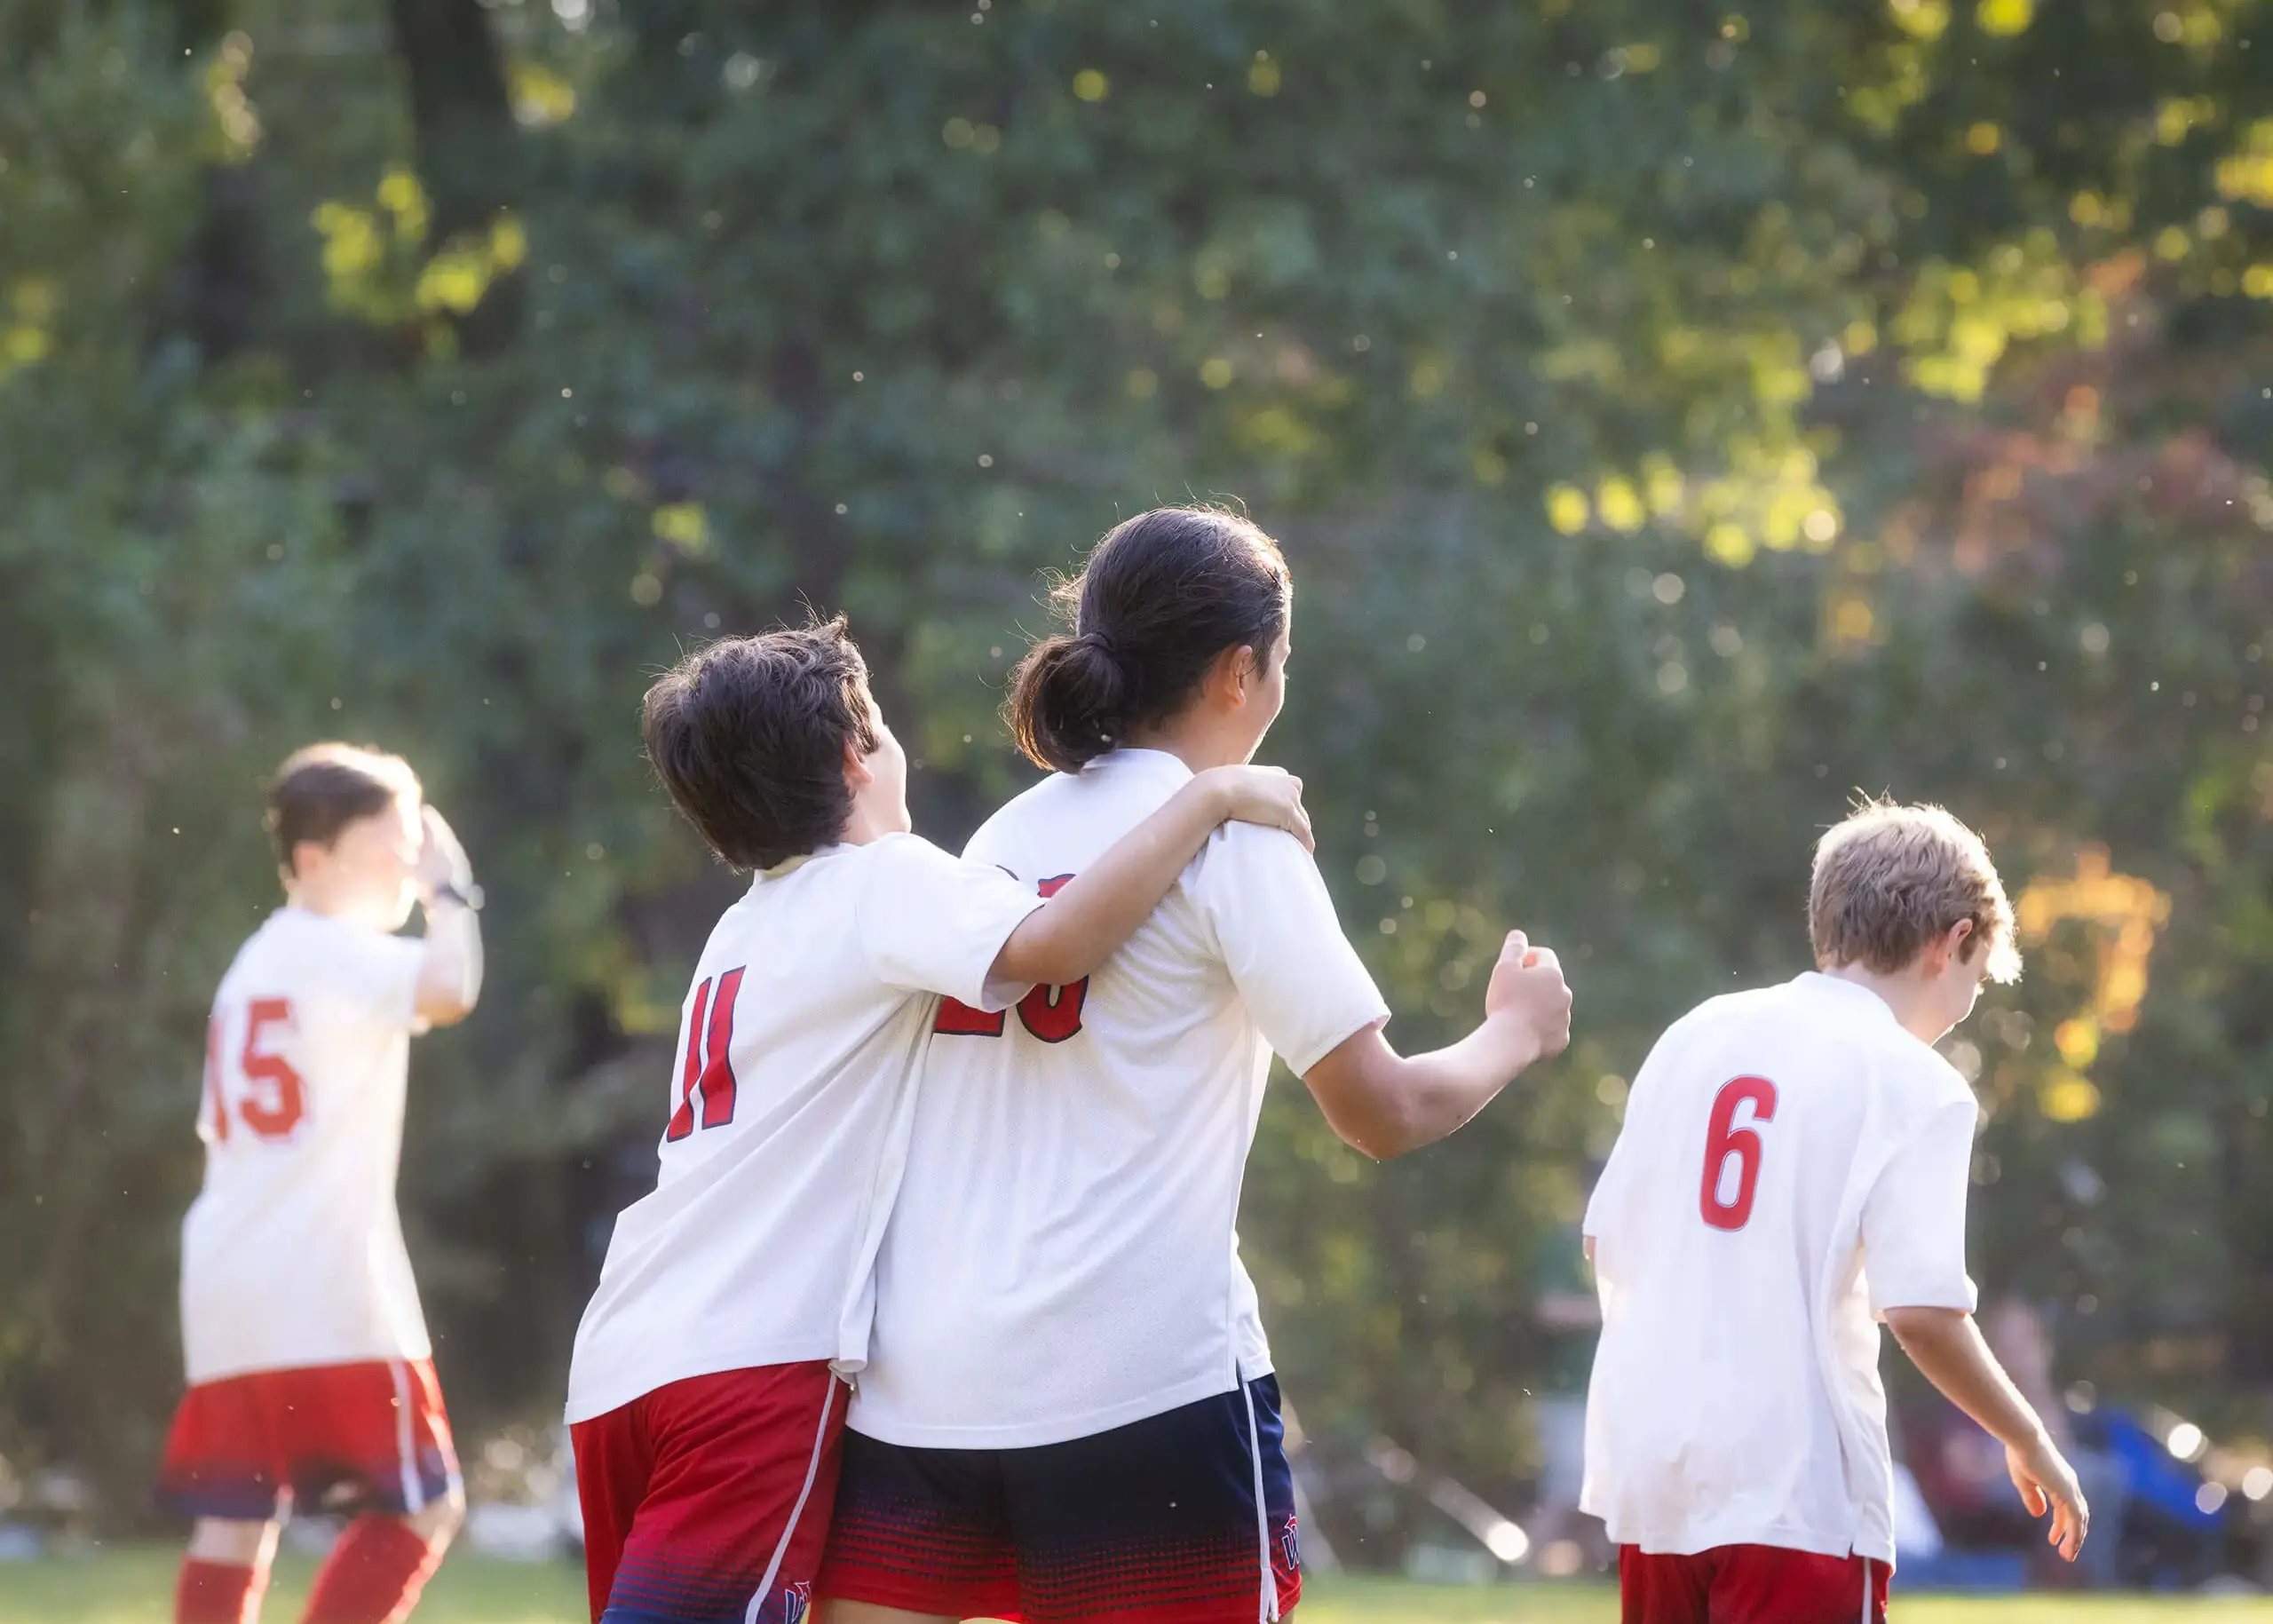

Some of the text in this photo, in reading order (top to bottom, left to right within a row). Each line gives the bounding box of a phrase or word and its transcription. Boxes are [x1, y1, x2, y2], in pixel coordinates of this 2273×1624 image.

[206, 996, 307, 1144] 15
[666, 964, 747, 1143] 11
[1699, 1073, 1779, 1232] 6
